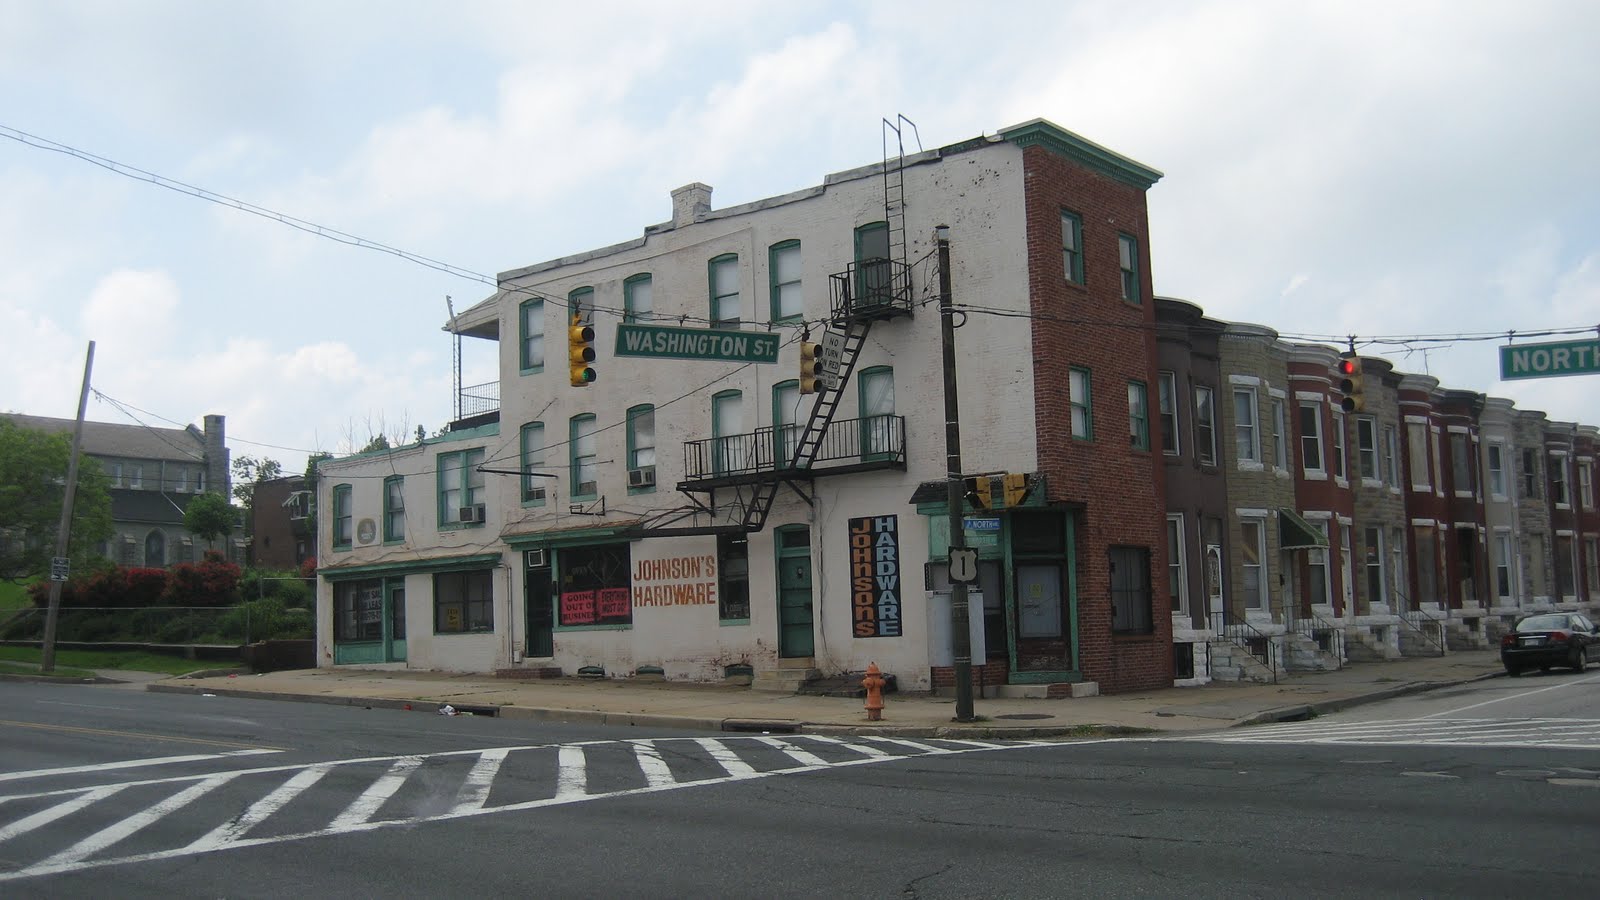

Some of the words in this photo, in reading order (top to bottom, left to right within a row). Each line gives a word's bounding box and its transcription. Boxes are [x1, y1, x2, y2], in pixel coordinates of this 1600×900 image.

[625, 330, 748, 356] WASHINGTON
[753, 339, 774, 356] ST.
[829, 337, 839, 347] NO
[825, 347, 839, 358] TURN
[828, 361, 839, 370] RED
[972, 520, 992, 529] NORTH
[633, 555, 715, 581] JOHNSON'S
[960, 555, 966, 576] 1
[875, 516, 899, 635] HARDWARE
[567, 592, 594, 602] GOING
[633, 582, 716, 608] HARDWARE
[368, 600, 382, 609] LEAS
[566, 603, 583, 611] OUT
[563, 611, 595, 621] BUSINE
